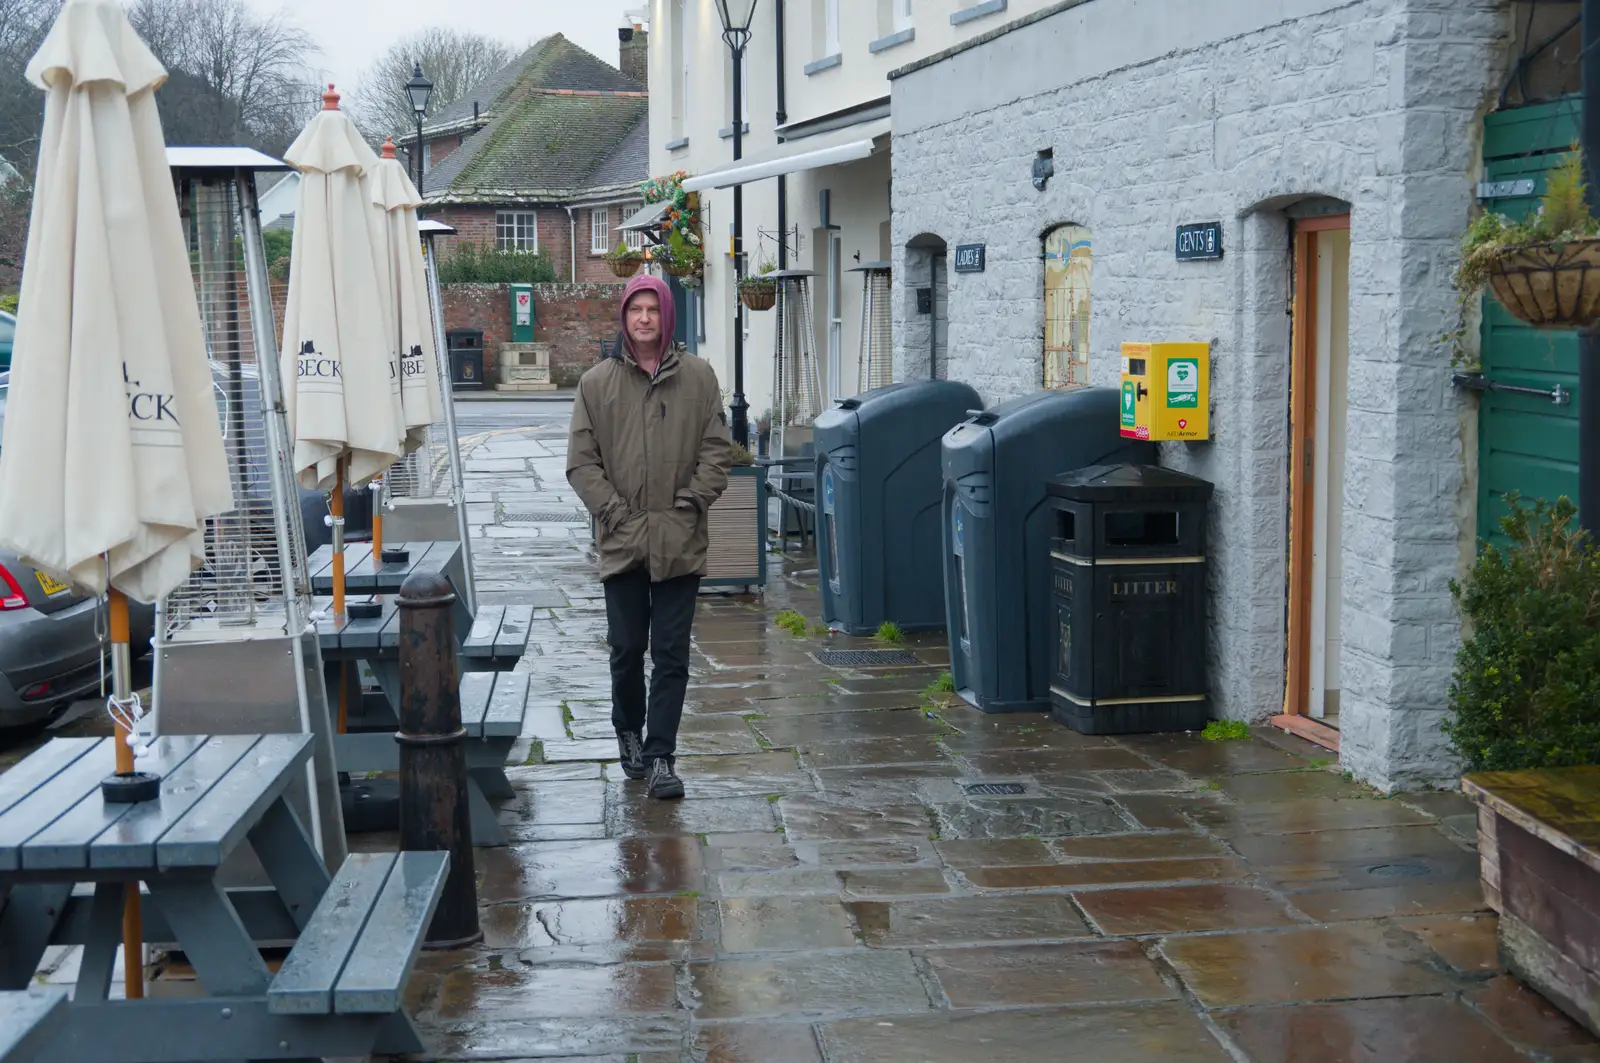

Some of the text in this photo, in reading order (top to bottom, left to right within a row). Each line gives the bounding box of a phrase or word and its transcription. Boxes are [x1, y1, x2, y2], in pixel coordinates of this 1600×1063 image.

[1179, 230, 1204, 252] GENTS
[957, 249, 974, 265] LADIES
[126, 392, 181, 427] CK
[1112, 581, 1177, 595] LITTER
